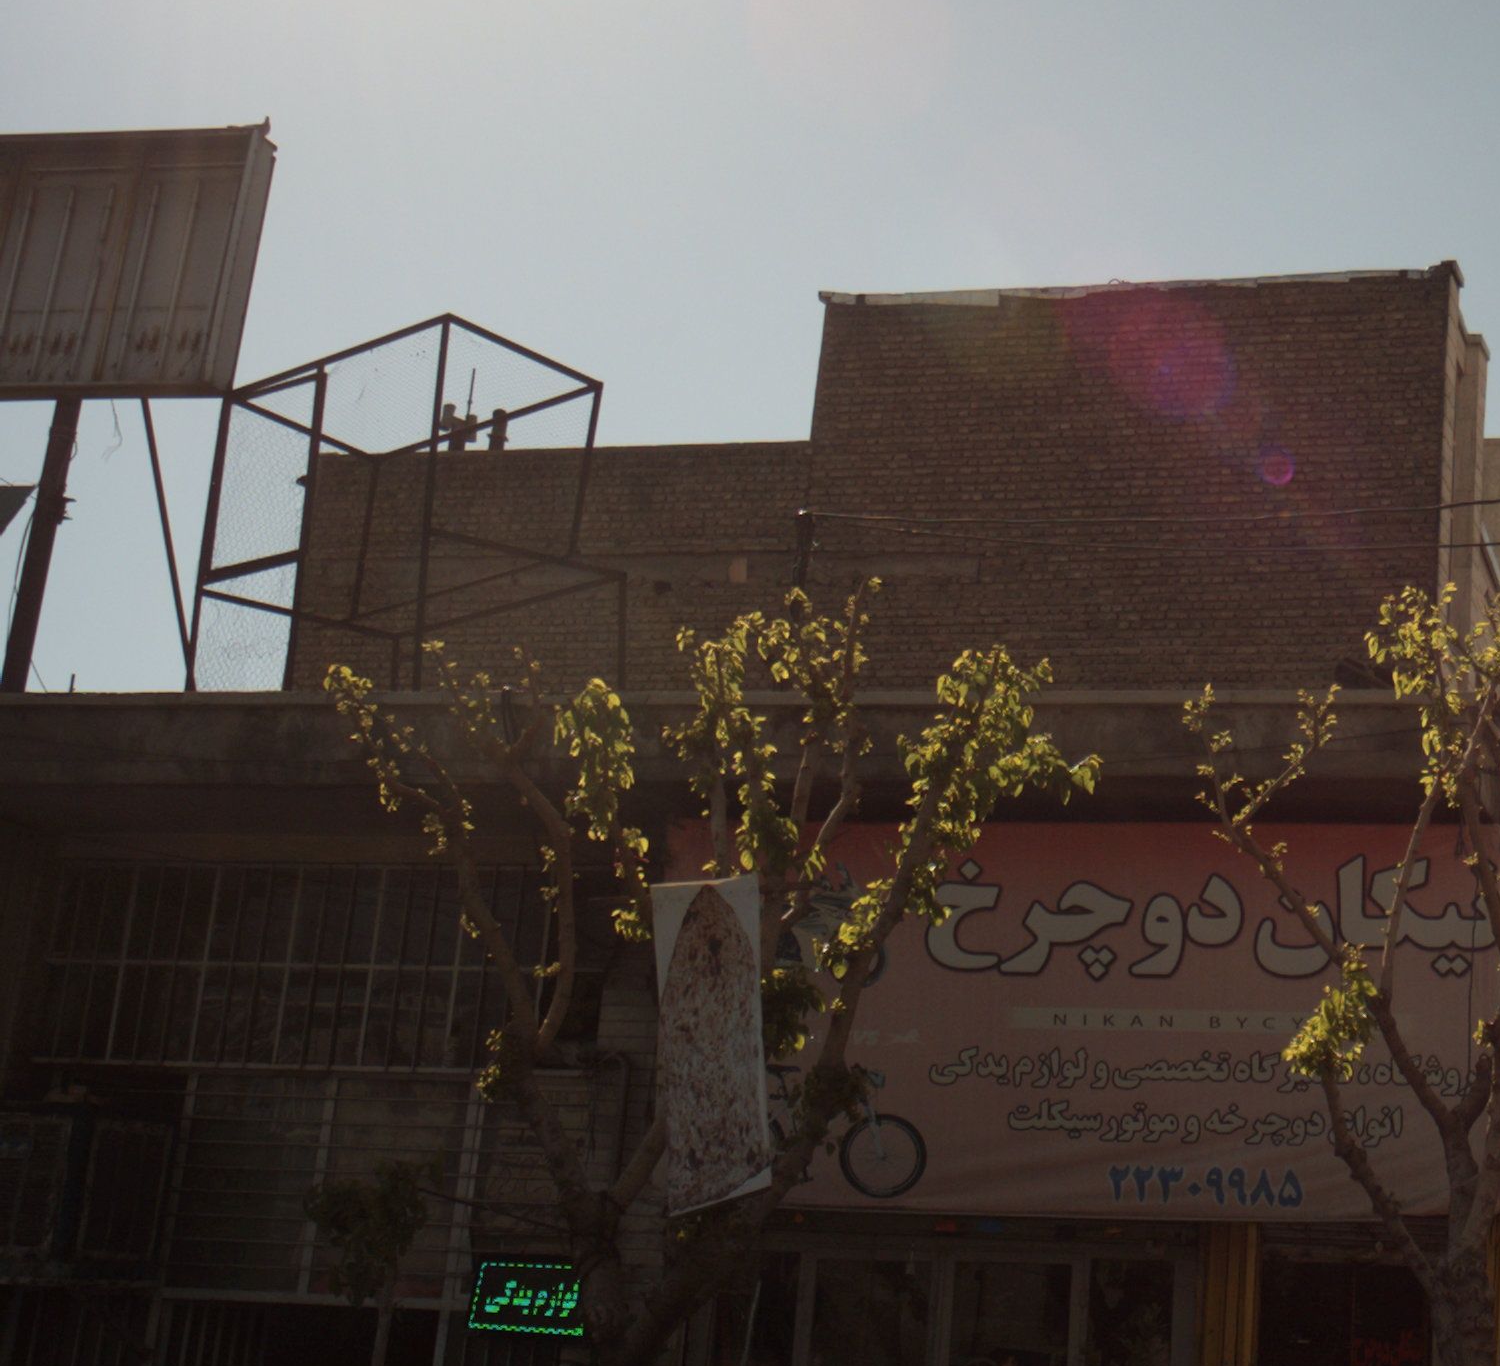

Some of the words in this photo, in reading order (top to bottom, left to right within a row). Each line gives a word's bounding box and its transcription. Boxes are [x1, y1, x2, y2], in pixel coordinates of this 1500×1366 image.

[1053, 1013, 1174, 1029] NIKAN
[1208, 1015, 1305, 1030] BYCY
[929, 1046, 1010, 1086] یدکی
[1013, 1046, 1089, 1089] لوازم
[1090, 1059, 1110, 1090] و
[1112, 1049, 1232, 1090] تخصصی
[1181, 1114, 1201, 1143] و
[1108, 1164, 1304, 1208] ۲۲۳۰۹۹۸۵
